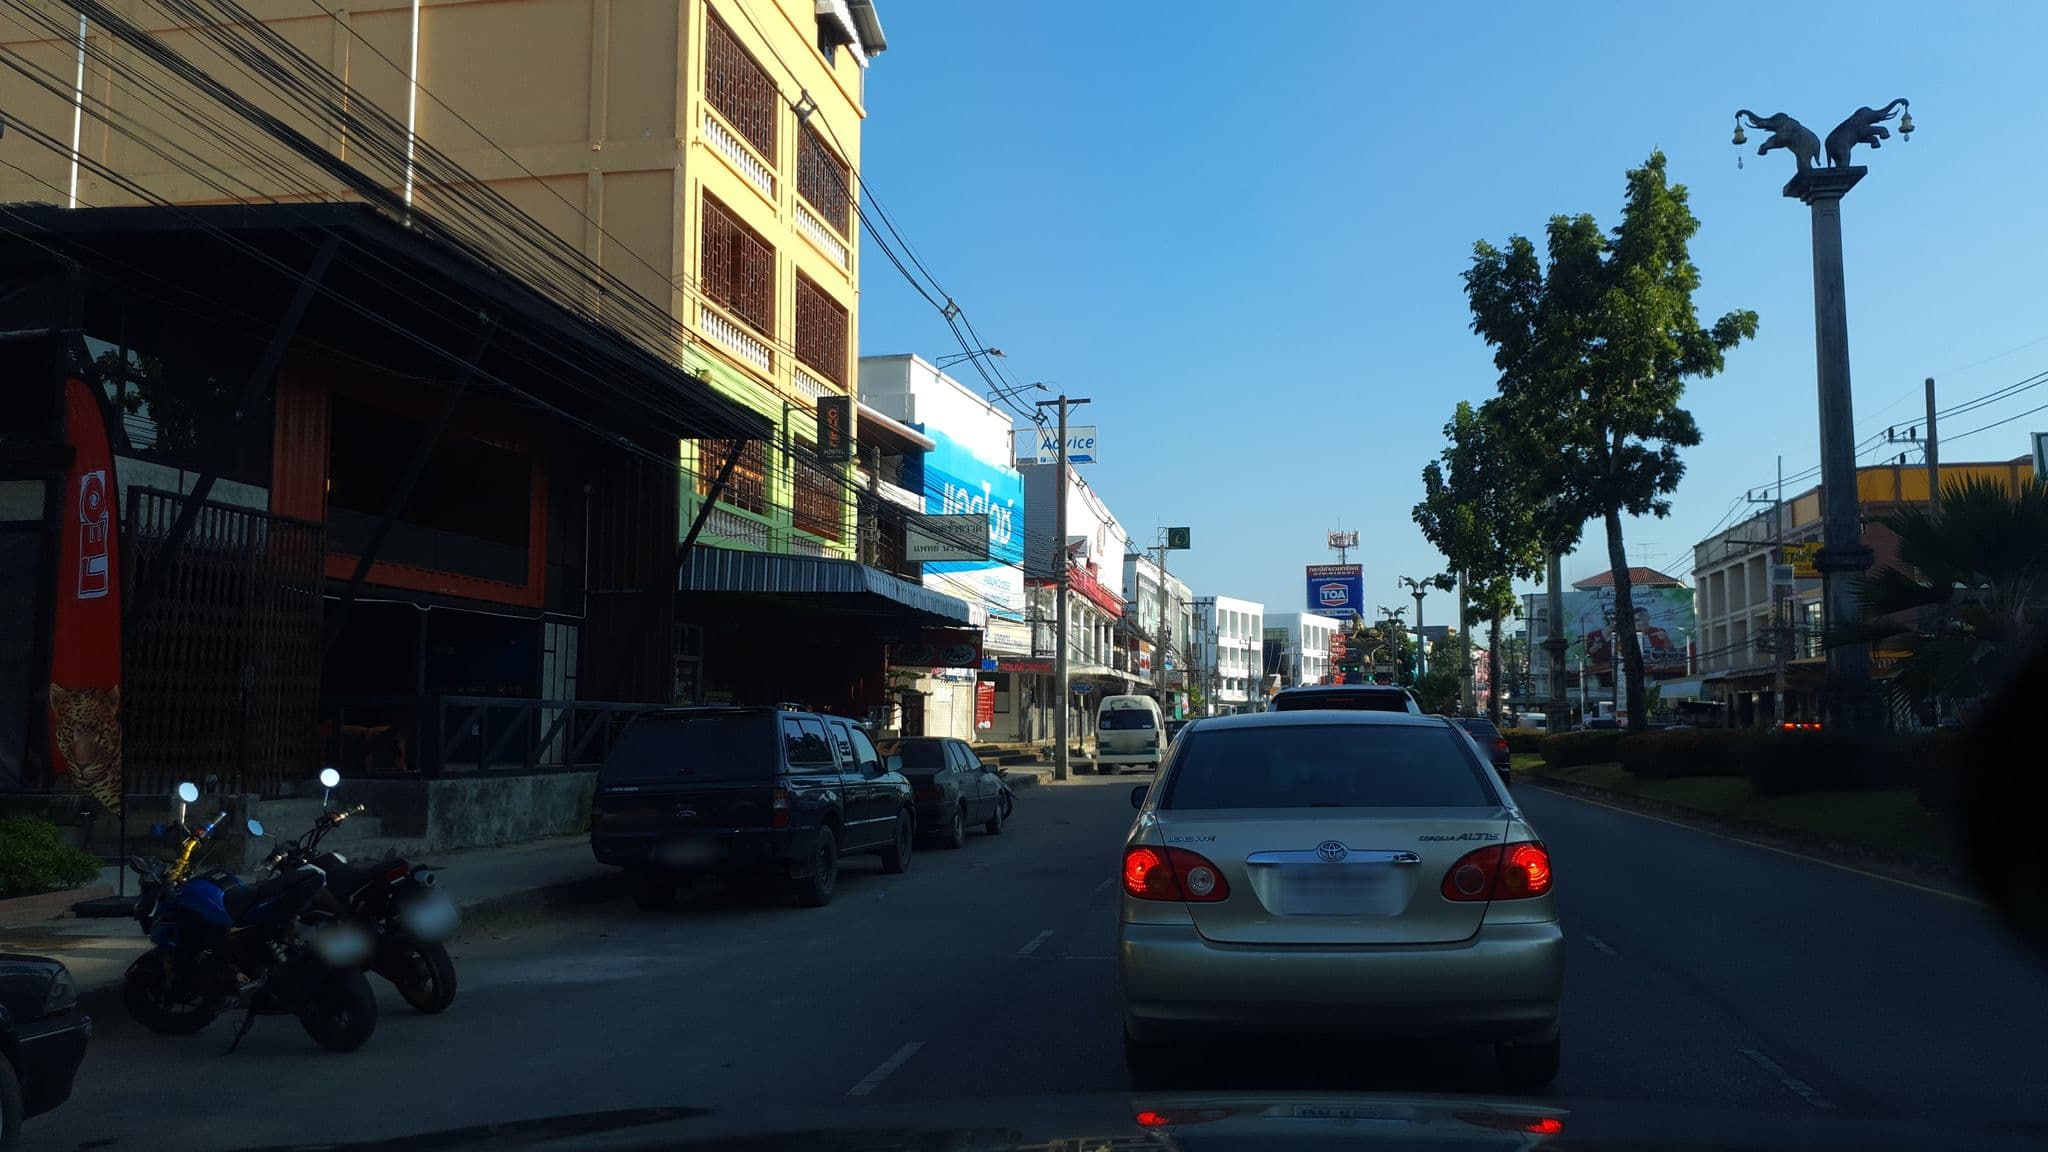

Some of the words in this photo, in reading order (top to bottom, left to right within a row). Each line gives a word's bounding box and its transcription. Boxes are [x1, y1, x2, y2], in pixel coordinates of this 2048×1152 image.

[78, 470, 110, 600] LEO
[1322, 590, 1346, 600] TOA
[1456, 832, 1501, 841] ALTIS
